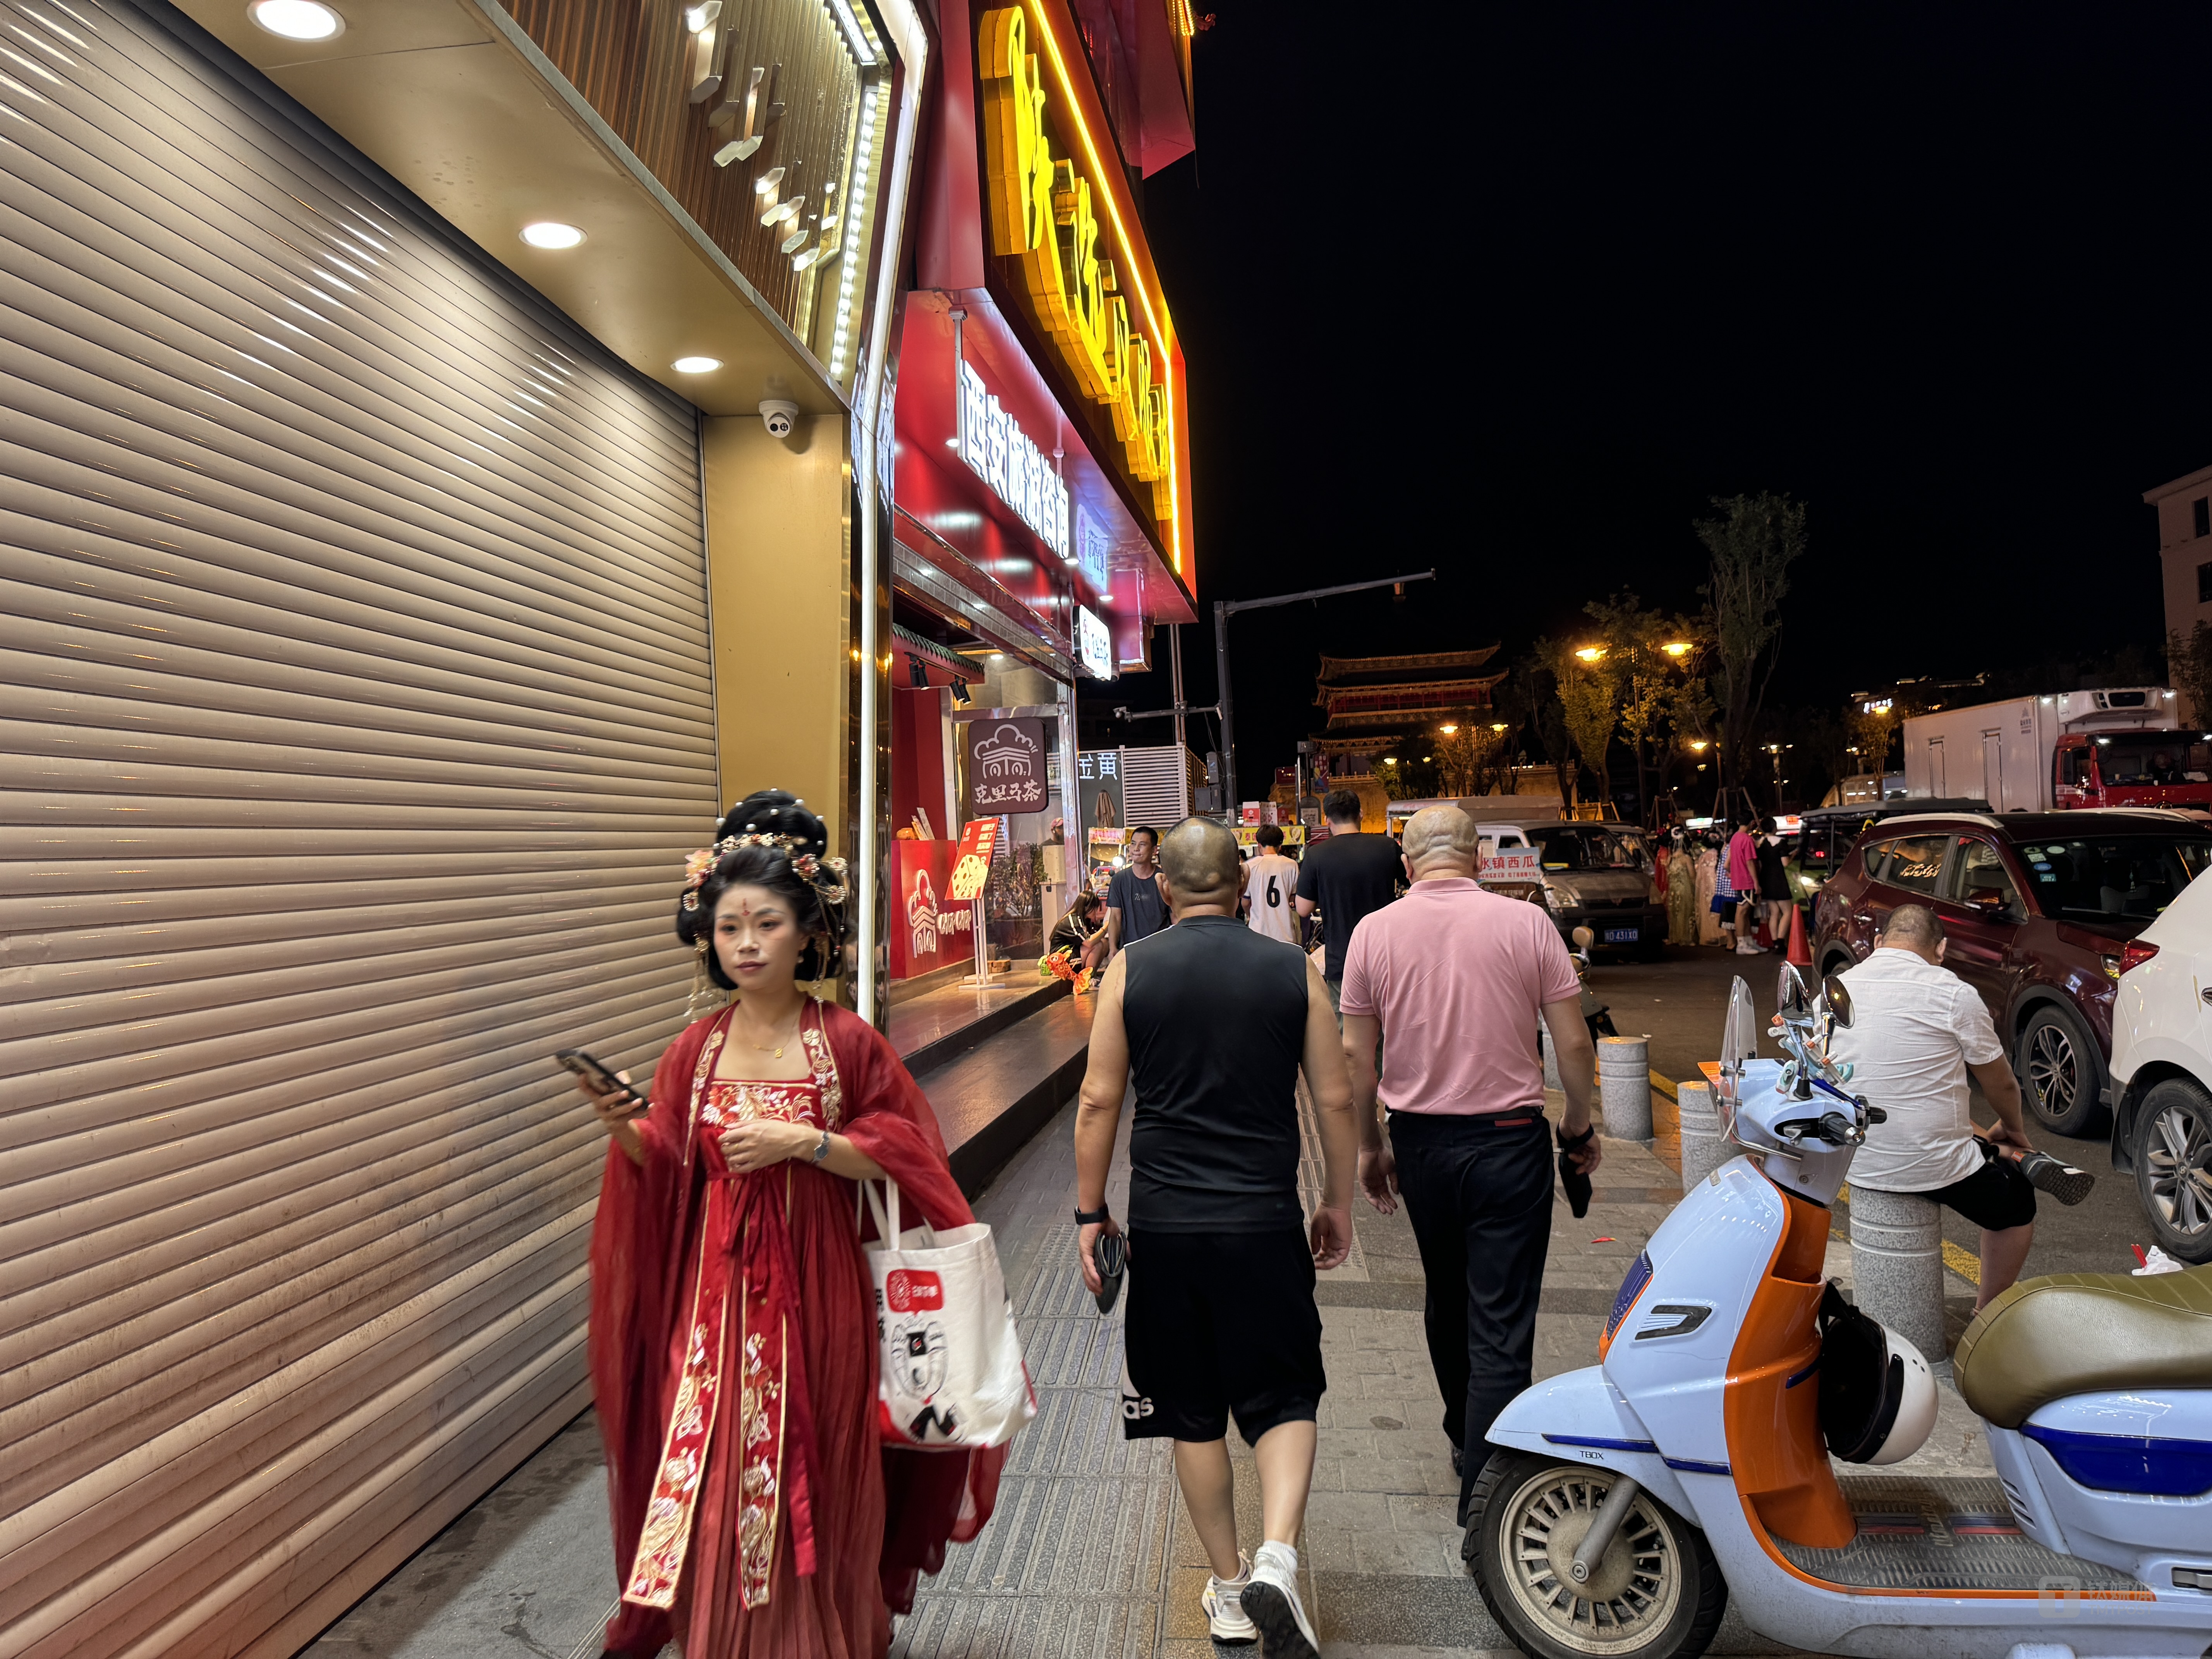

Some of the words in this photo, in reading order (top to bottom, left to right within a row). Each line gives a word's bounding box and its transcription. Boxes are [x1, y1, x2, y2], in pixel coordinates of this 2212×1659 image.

[960, 359, 1069, 559] 西安旅游咨询
[1266, 875, 1280, 908] 6
[1580, 1451, 1604, 1460] TBOX
